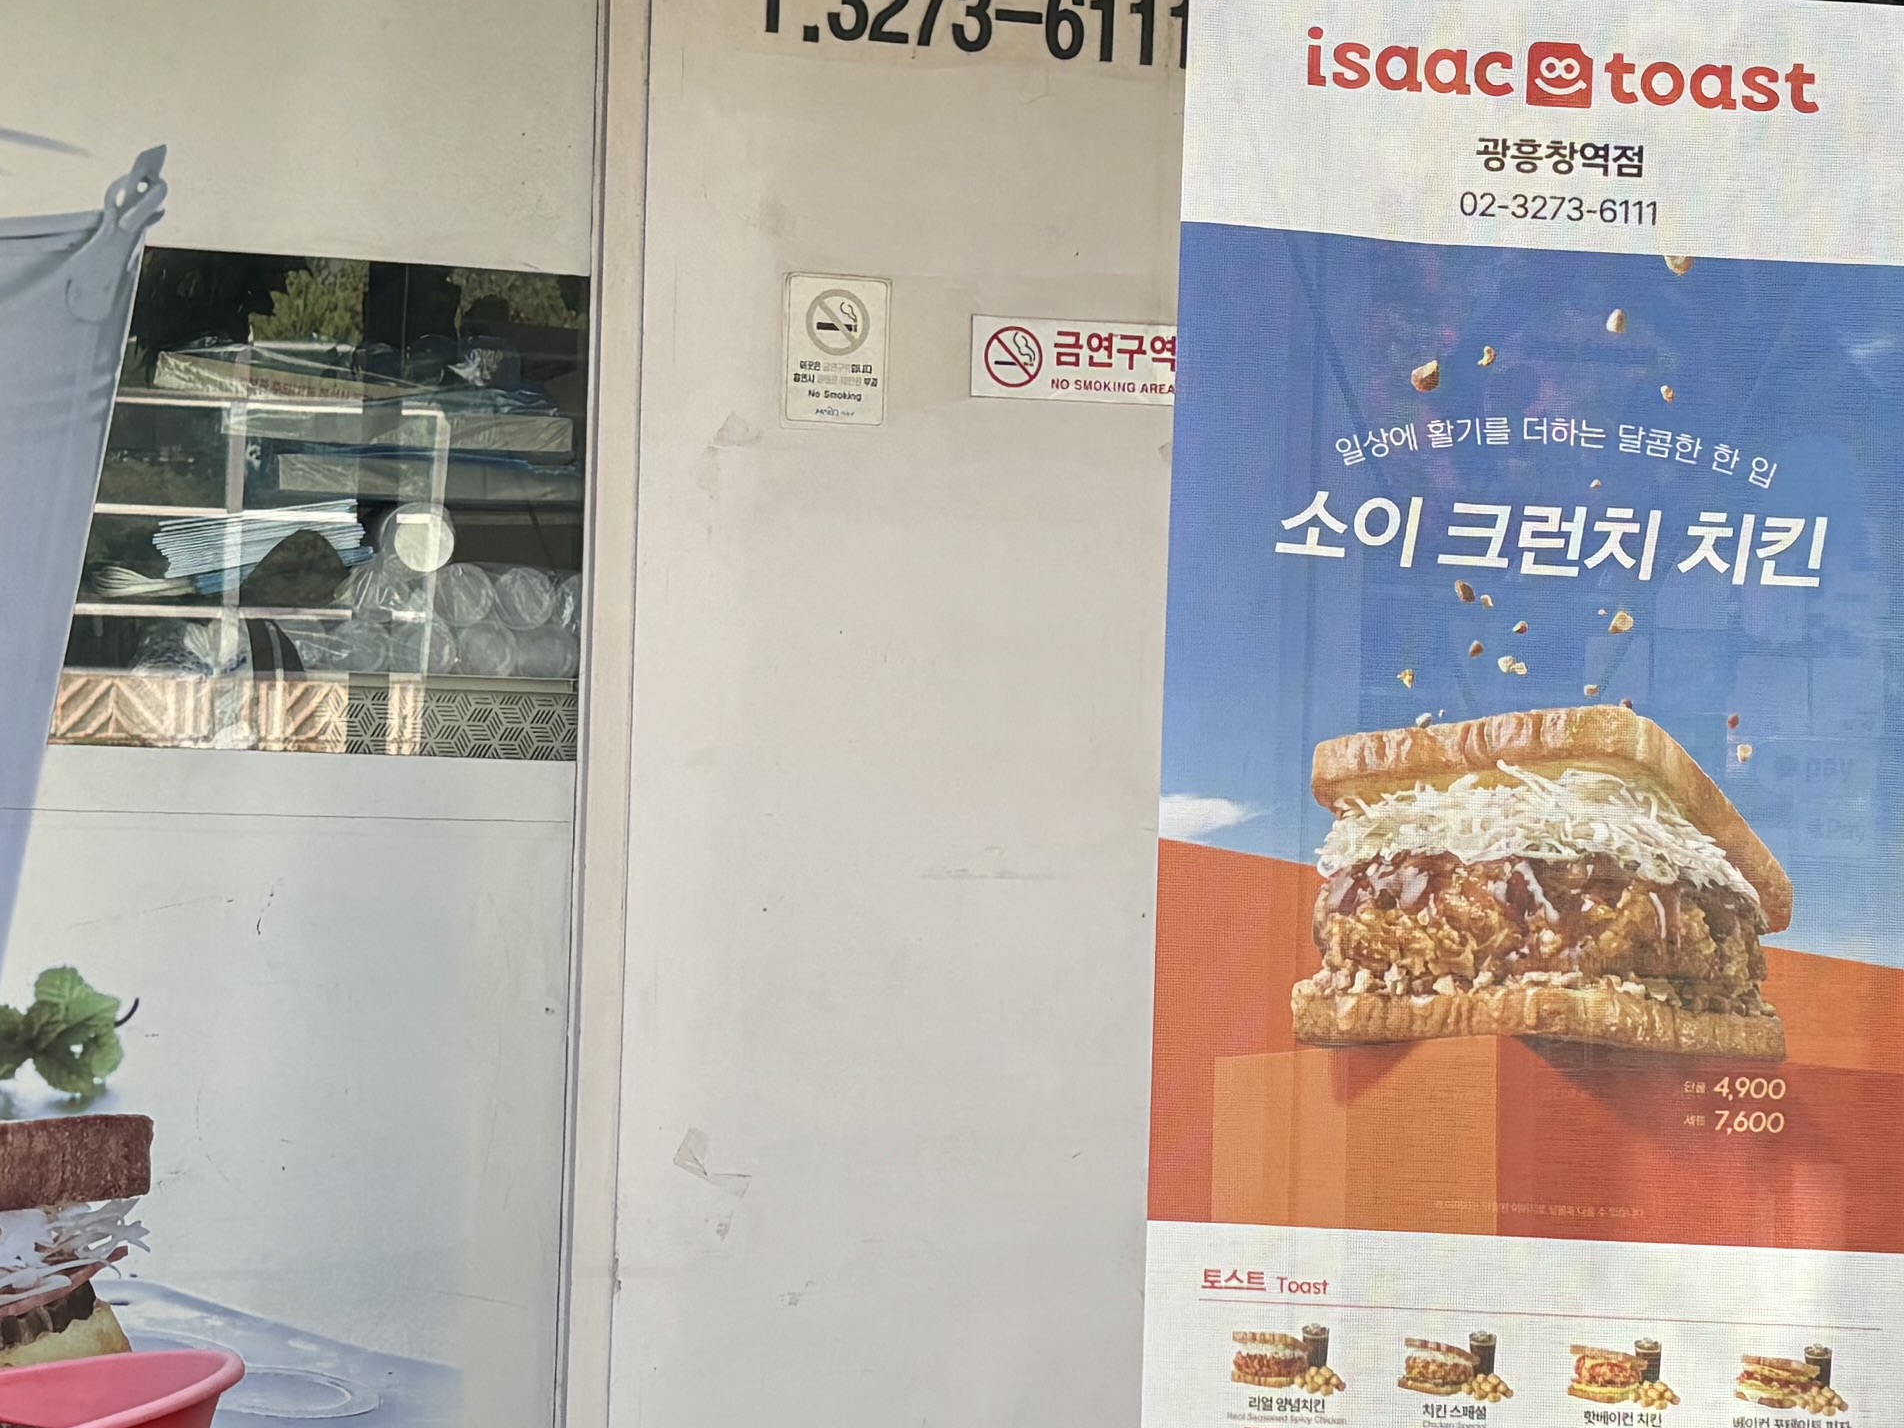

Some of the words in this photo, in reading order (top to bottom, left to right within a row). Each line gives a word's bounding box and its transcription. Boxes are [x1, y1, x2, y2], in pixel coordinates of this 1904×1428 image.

[1306, 26, 1515, 98] isaac
[1604, 52, 1820, 114] toast
[1476, 137, 1645, 179] 광흥창역점
[1459, 192, 1659, 227] 02-3273-6111
[1054, 331, 1176, 372] 금연구역
[808, 390, 820, 398] No
[824, 390, 862, 402] Smoking
[1051, 379, 1069, 390] NO
[1075, 379, 1136, 393] SMOKING
[1140, 384, 1175, 394] AREA
[1335, 420, 1418, 469] 일상에
[1426, 416, 1512, 450] 활기를
[1522, 415, 1607, 451] 더하는
[1617, 421, 1702, 463] 달콤한
[1712, 442, 1740, 475] 한
[1752, 455, 1777, 489] 입
[1274, 490, 1422, 568] 소이
[1437, 500, 1661, 581] 크런치
[1677, 510, 1828, 587] 치킨
[1713, 1076, 1787, 1101] 4,900
[1714, 1110, 1785, 1136] 7,600
[1202, 1268, 1267, 1292] 토스트
[1277, 1277, 1328, 1295] Toast
[1248, 1396, 1274, 1412] 리얼
[1276, 1398, 1326, 1414] 양념치킨
[1422, 1404, 1446, 1419] 치킨
[1637, 1413, 1662, 1428] 치킨
